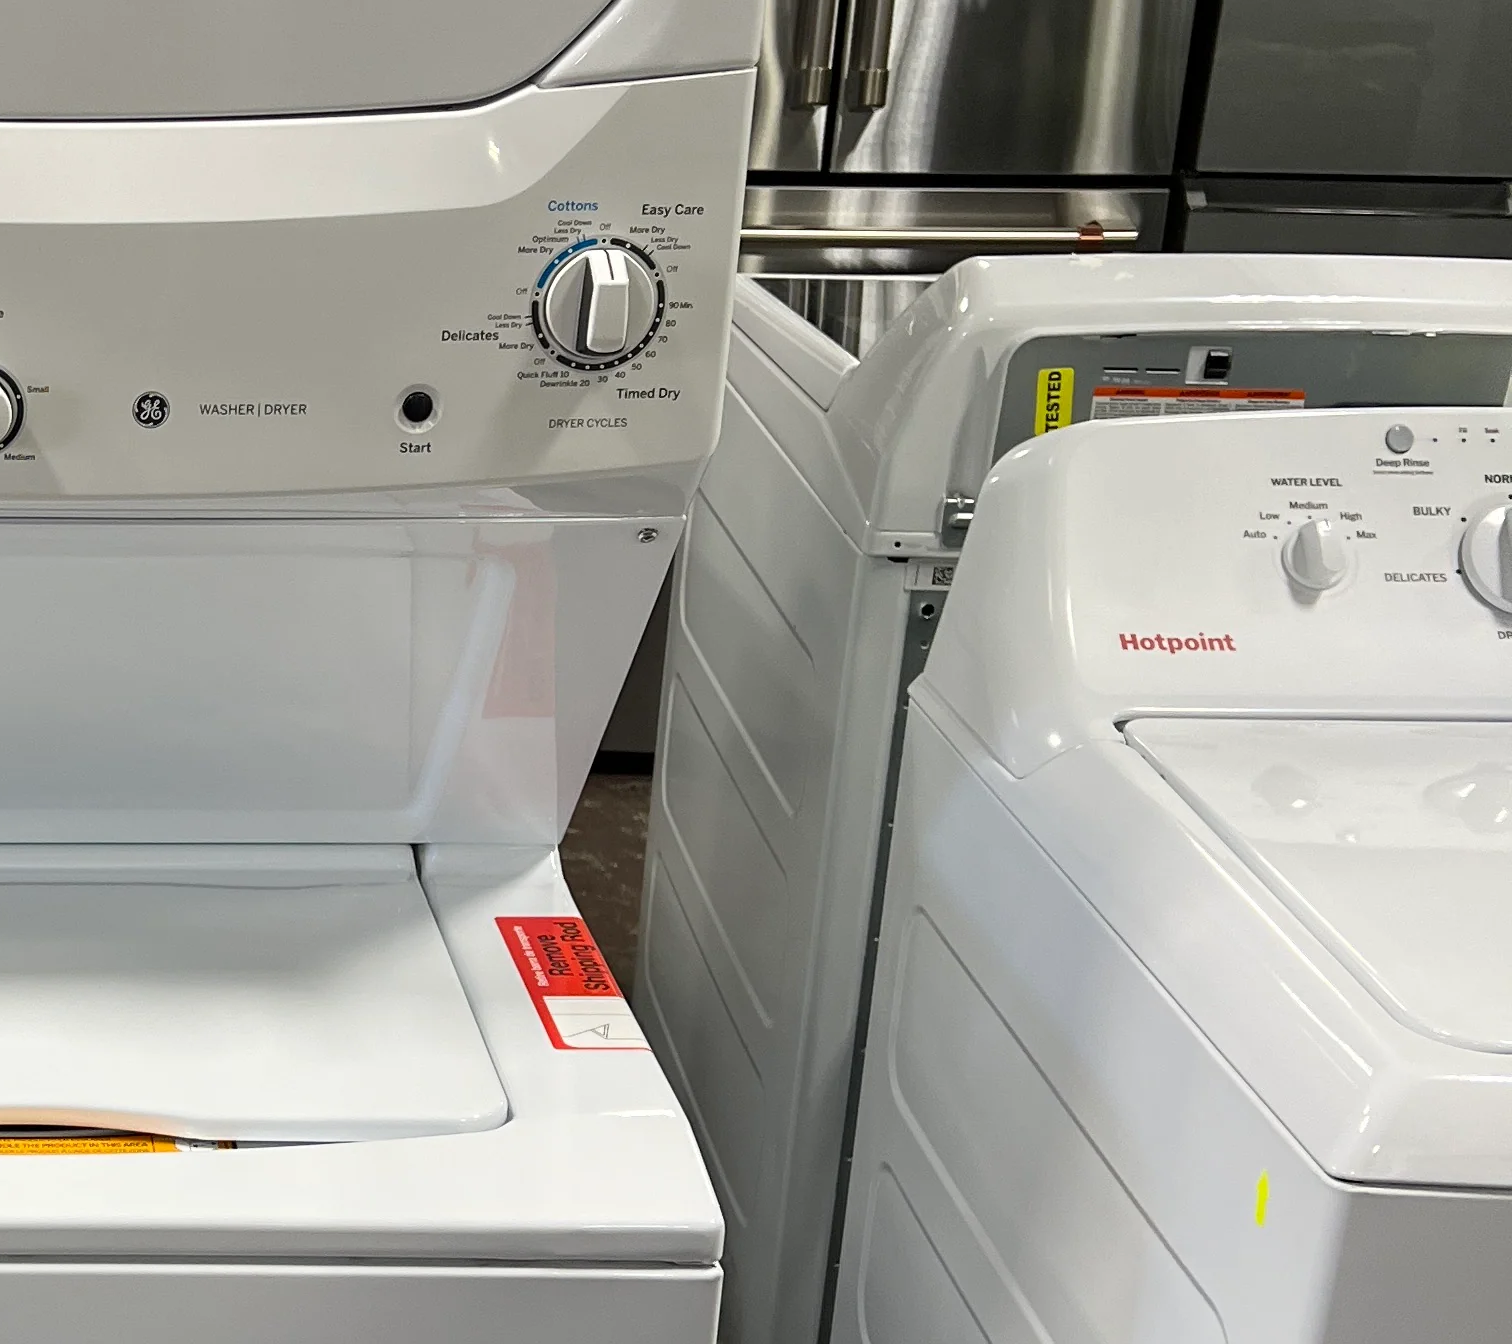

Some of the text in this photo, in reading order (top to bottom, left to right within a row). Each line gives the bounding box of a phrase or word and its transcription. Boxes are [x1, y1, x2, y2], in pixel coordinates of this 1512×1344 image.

[548, 200, 598, 212] Cottons
[642, 204, 704, 218] Easy Care
[570, 228, 582, 236] Dry
[600, 222, 612, 232] Off
[630, 226, 666, 235] More Dry
[668, 236, 679, 245] Dry
[518, 246, 554, 255] More Dry
[666, 264, 678, 274] Off
[516, 287, 528, 296] Off
[668, 301, 680, 309] 90
[665, 319, 676, 328] 80
[441, 330, 500, 342] Delicates
[658, 336, 668, 344] 70
[498, 342, 534, 352] More Dry
[645, 350, 656, 358] 60
[631, 363, 642, 372] 50
[516, 370, 570, 380] Quick Fluff 10
[597, 375, 608, 384] 30
[614, 371, 626, 380] 40
[579, 379, 590, 388] 20
[26, 385, 50, 394] Small
[616, 388, 680, 401] Timed Dry
[1045, 370, 1062, 432] TESTED
[199, 404, 308, 416] WASHER DRYER
[548, 418, 628, 429] DRYER CYCLES
[400, 442, 432, 454] Start
[4, 453, 36, 462] Medium
[1376, 458, 1430, 468] Deep Rinse
[1270, 478, 1343, 487] WATER LEVEL
[1484, 474, 1512, 484] NOR
[1289, 501, 1328, 510] Medium
[1258, 512, 1280, 520] Low
[1412, 506, 1452, 516] BULKY
[1340, 512, 1363, 522] High
[1242, 530, 1267, 538] Auto
[1356, 530, 1378, 540] Max
[1384, 572, 1448, 582] DELICATES
[1119, 632, 1237, 654] Hotpoint
[536, 934, 575, 977] Remove
[553, 921, 611, 992] Shipping Rod
